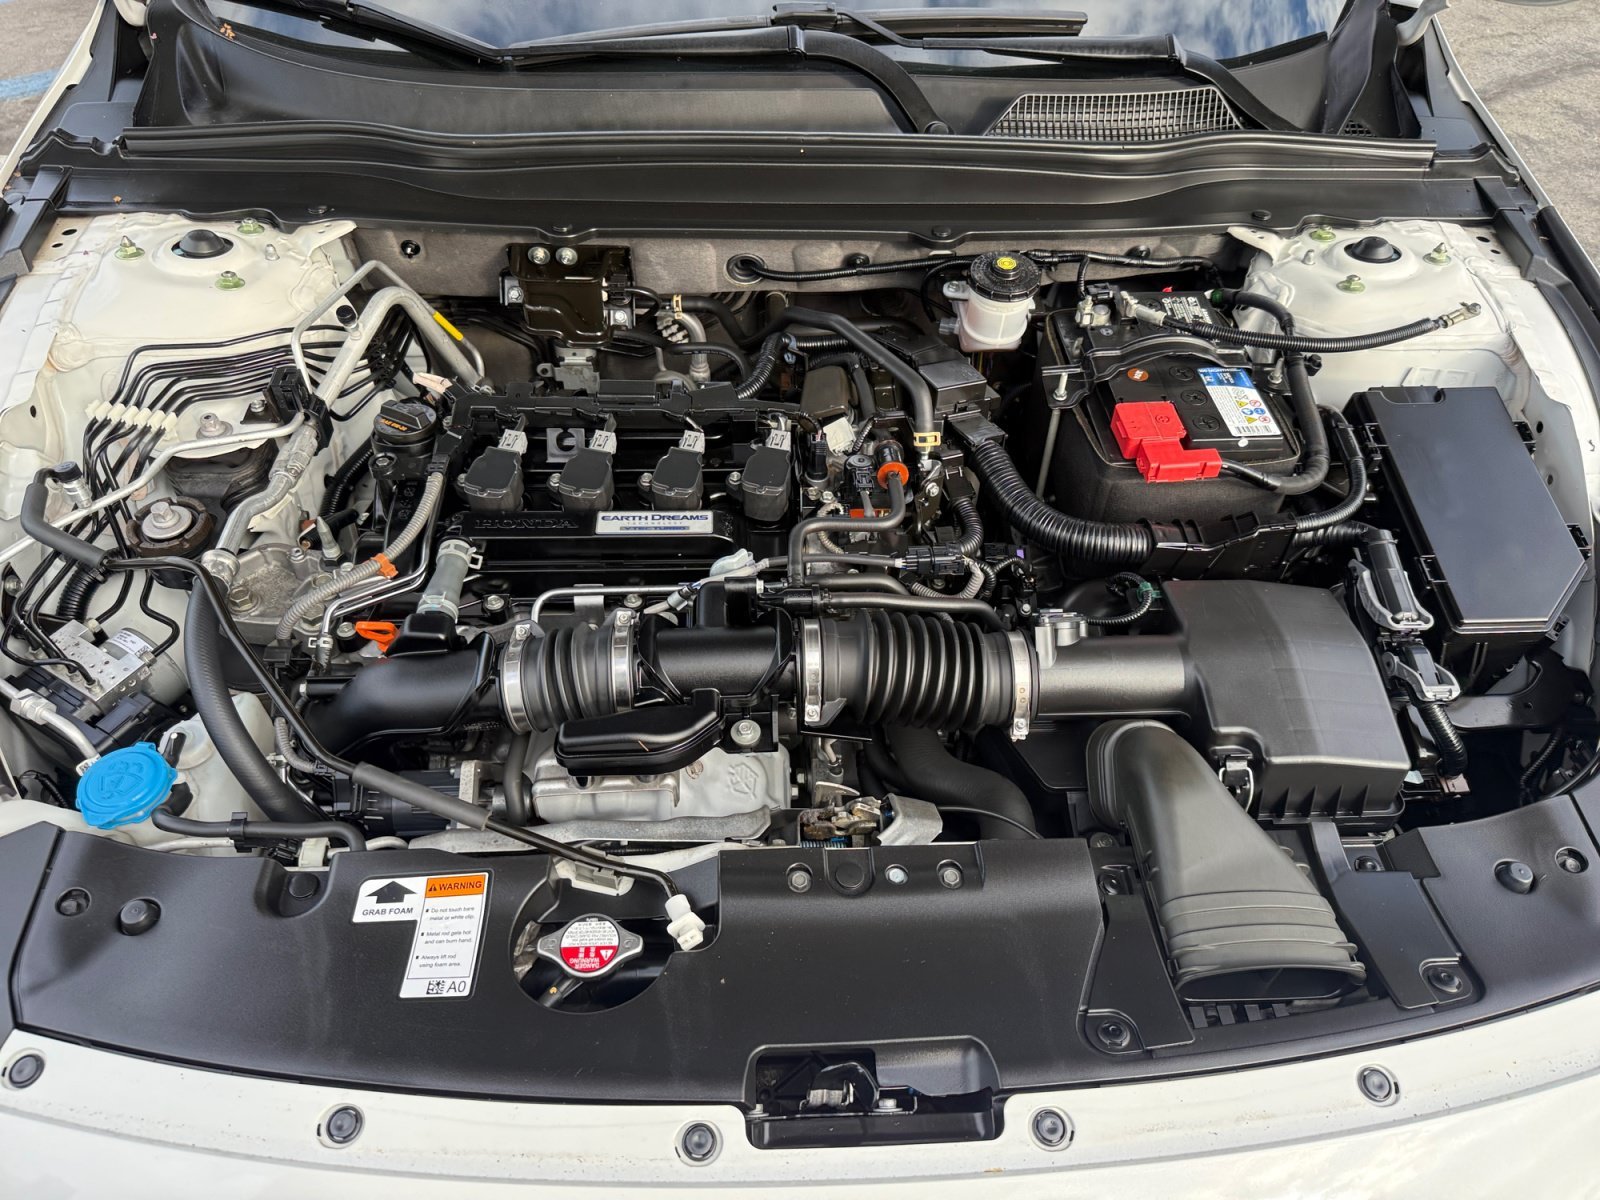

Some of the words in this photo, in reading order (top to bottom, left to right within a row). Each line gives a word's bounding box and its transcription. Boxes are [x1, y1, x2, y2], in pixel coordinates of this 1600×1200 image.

[474, 519, 579, 528] HONDA
[439, 881, 482, 891] WARNING
[362, 908, 387, 916] GRAB
[389, 907, 413, 915] FOAM
